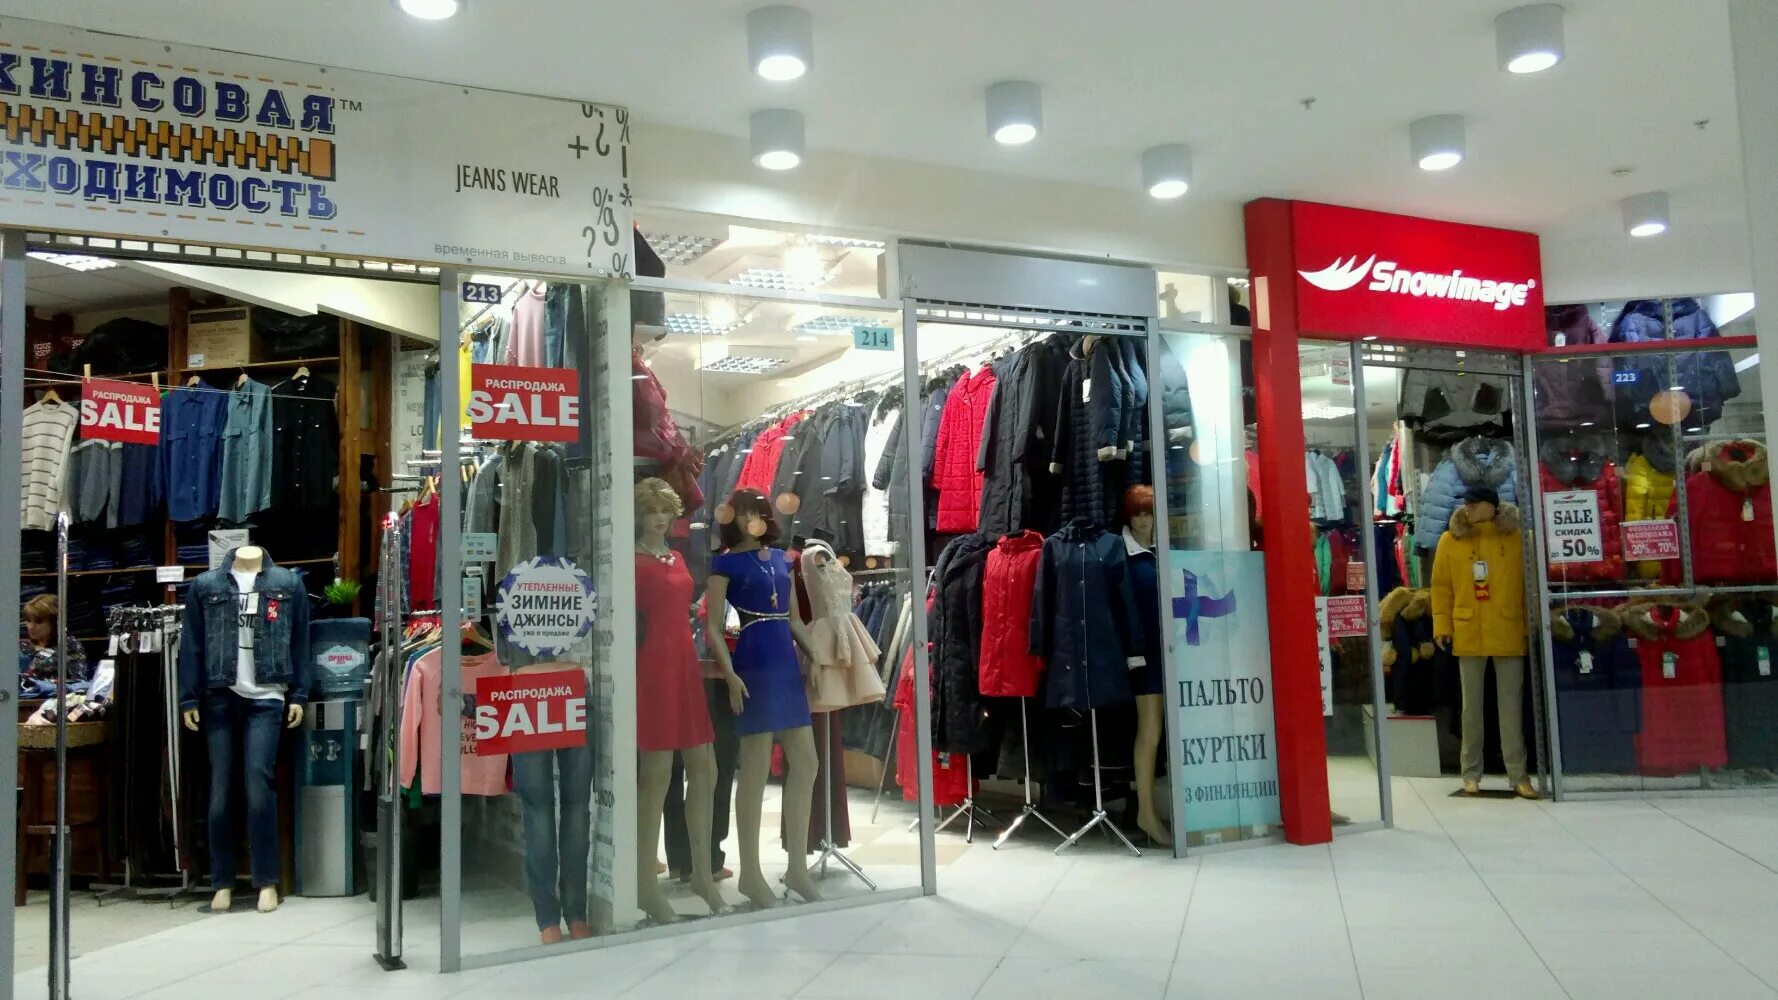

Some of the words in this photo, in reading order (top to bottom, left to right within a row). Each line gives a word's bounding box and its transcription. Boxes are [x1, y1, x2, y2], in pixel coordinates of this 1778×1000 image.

[456, 164, 506, 193] JEANS
[512, 171, 560, 198] WEAR
[434, 243, 509, 261] временная
[513, 250, 567, 265] вывеска
[466, 284, 499, 302] 213
[1368, 260, 1528, 311] Snowimage
[861, 329, 890, 347] 214
[485, 378, 566, 393] РАСПРОДАЖА
[1615, 372, 1637, 383] 223
[92, 389, 151, 405] РАСПРОДАЖА
[80, 399, 161, 433] SALE
[467, 390, 580, 428] SALE
[1553, 509, 1593, 525] SALE
[517, 582, 580, 593] УТЕПЛЕННЫЕ
[511, 594, 583, 611] ЗИМНИЕ
[513, 612, 580, 629] ДЖИНСЫ
[523, 630, 535, 638] уже
[543, 629, 571, 638] продаже
[491, 686, 572, 702] РАСПРОДАЖА
[1178, 677, 1264, 707] ПАЛЬТО
[476, 698, 587, 740] SALE
[1182, 734, 1267, 766] КУРТКИ
[1194, 780, 1278, 802] ФИНЛЯНДИИ
